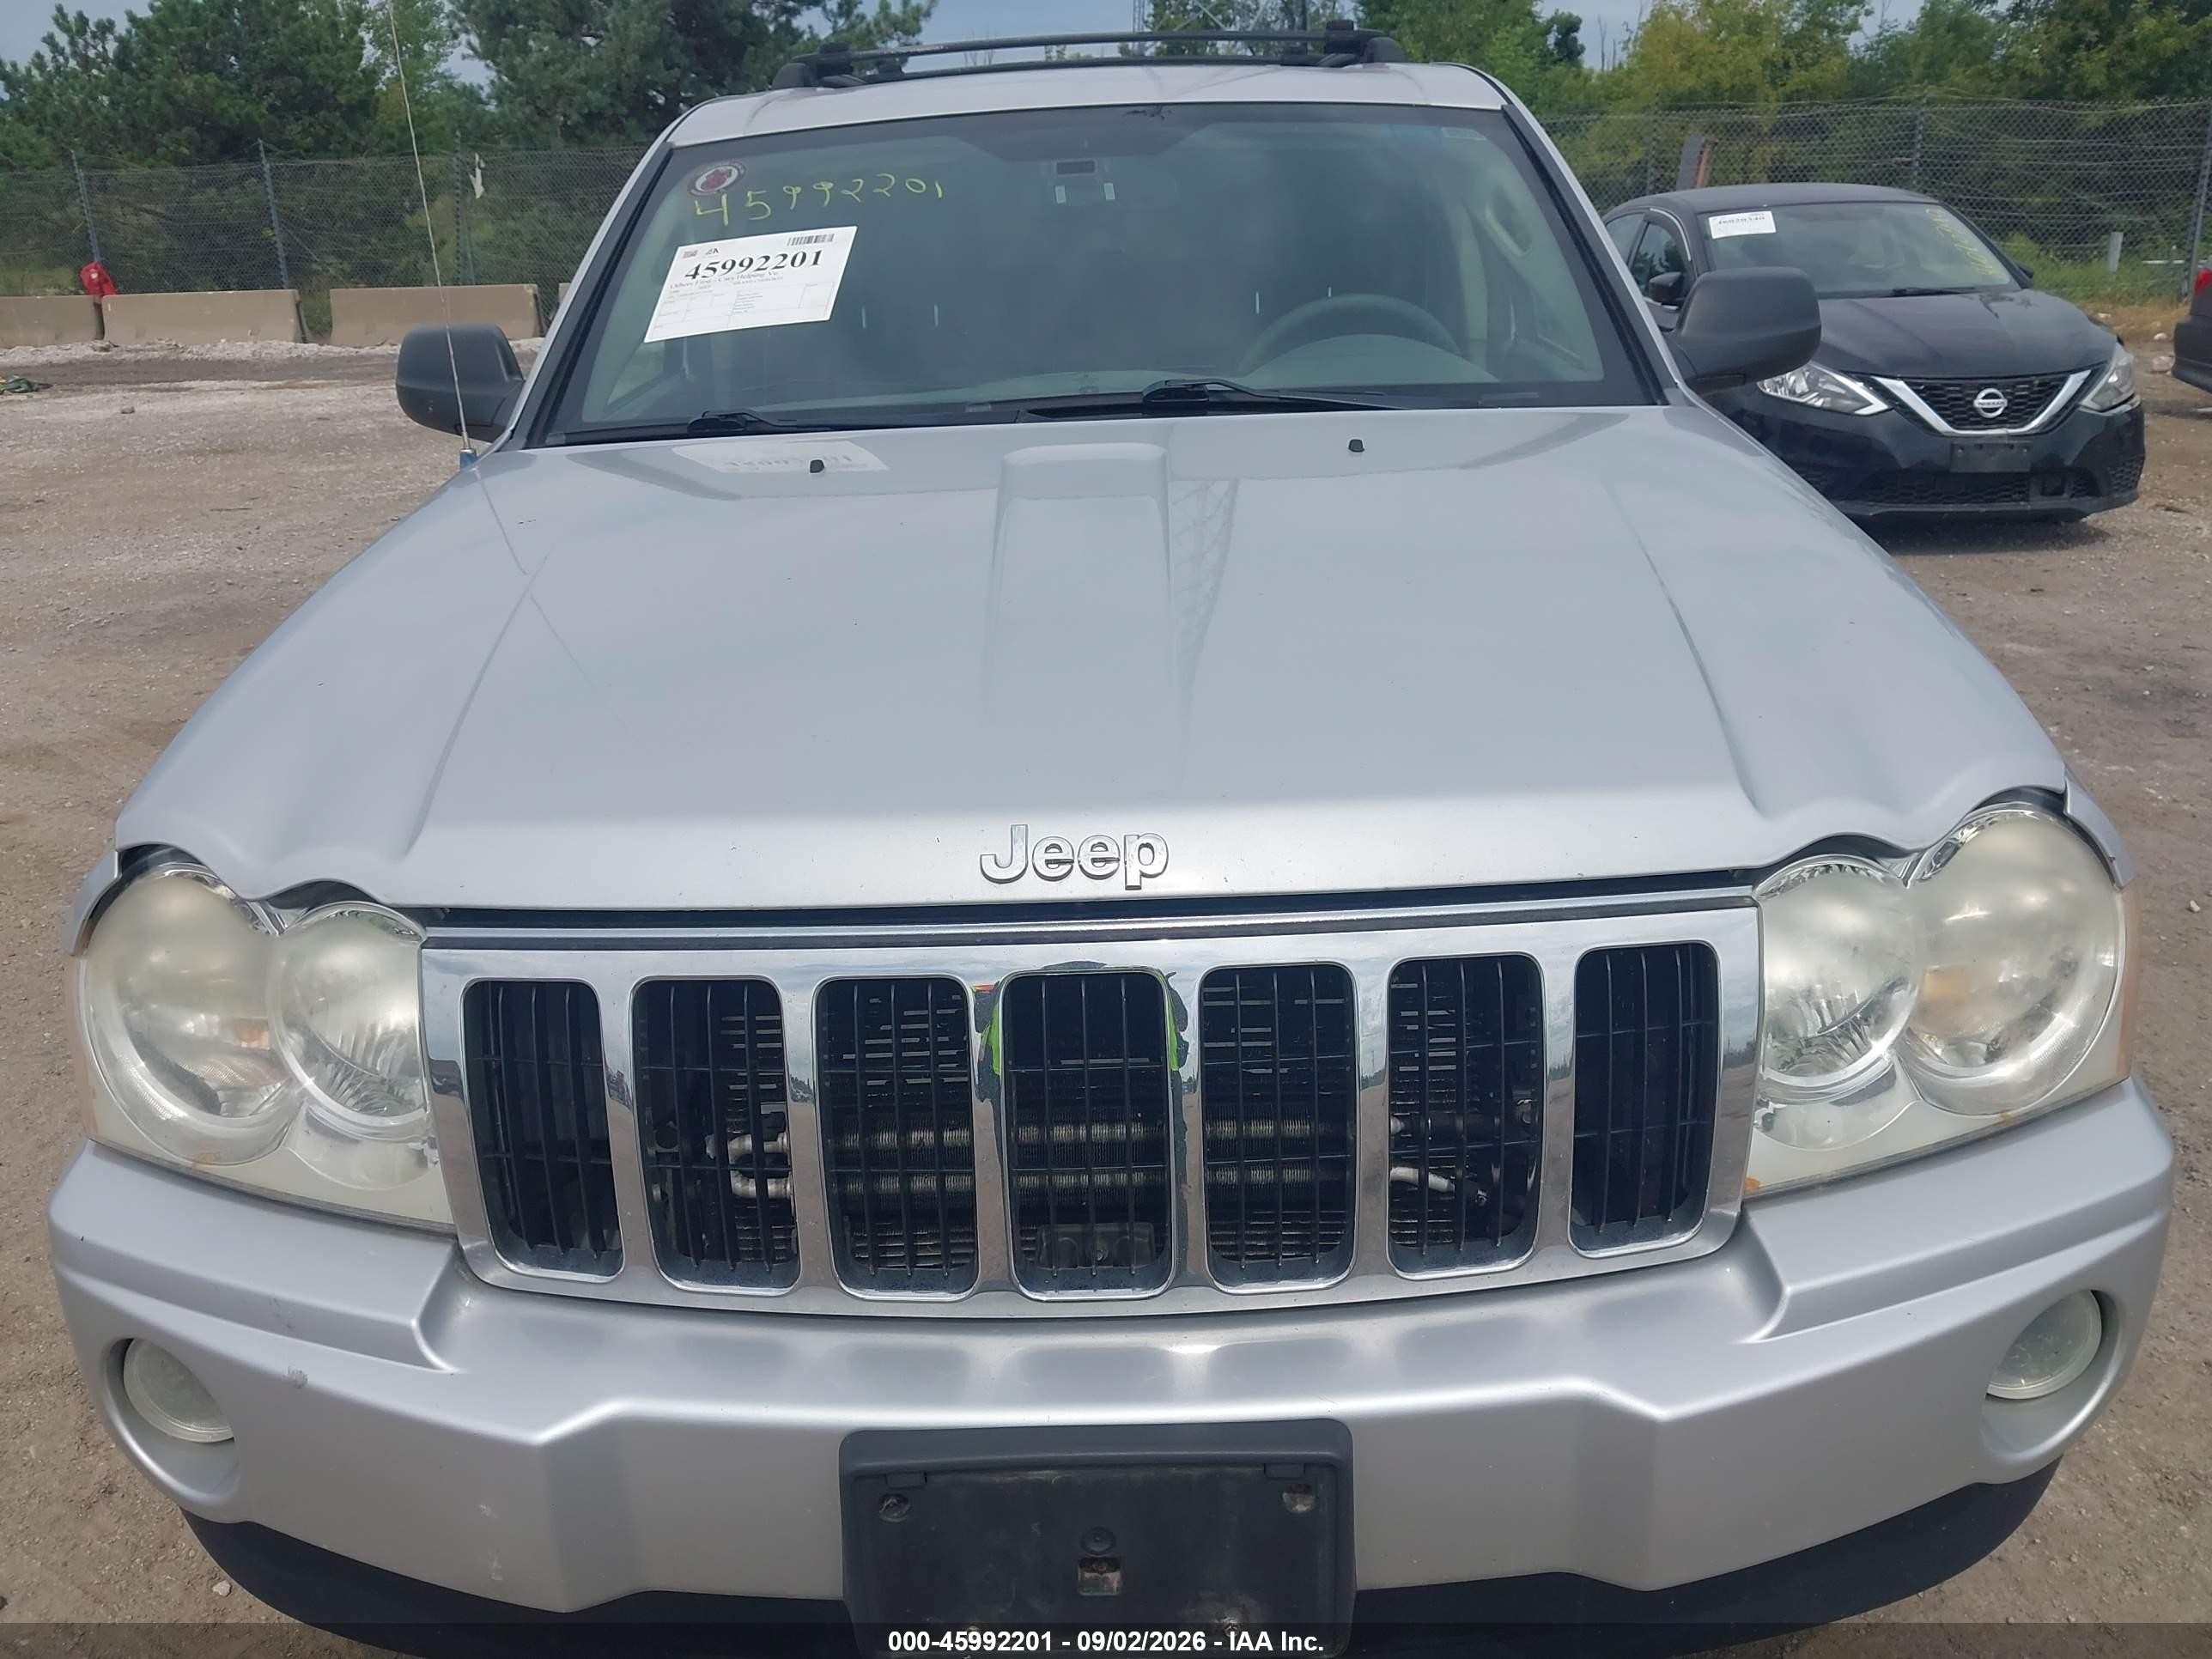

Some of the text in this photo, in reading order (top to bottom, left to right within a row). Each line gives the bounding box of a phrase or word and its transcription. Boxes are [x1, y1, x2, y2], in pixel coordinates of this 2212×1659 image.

[695, 173, 942, 226] 45992201
[684, 250, 823, 280] 45992201
[980, 824, 1169, 890] Jeep
